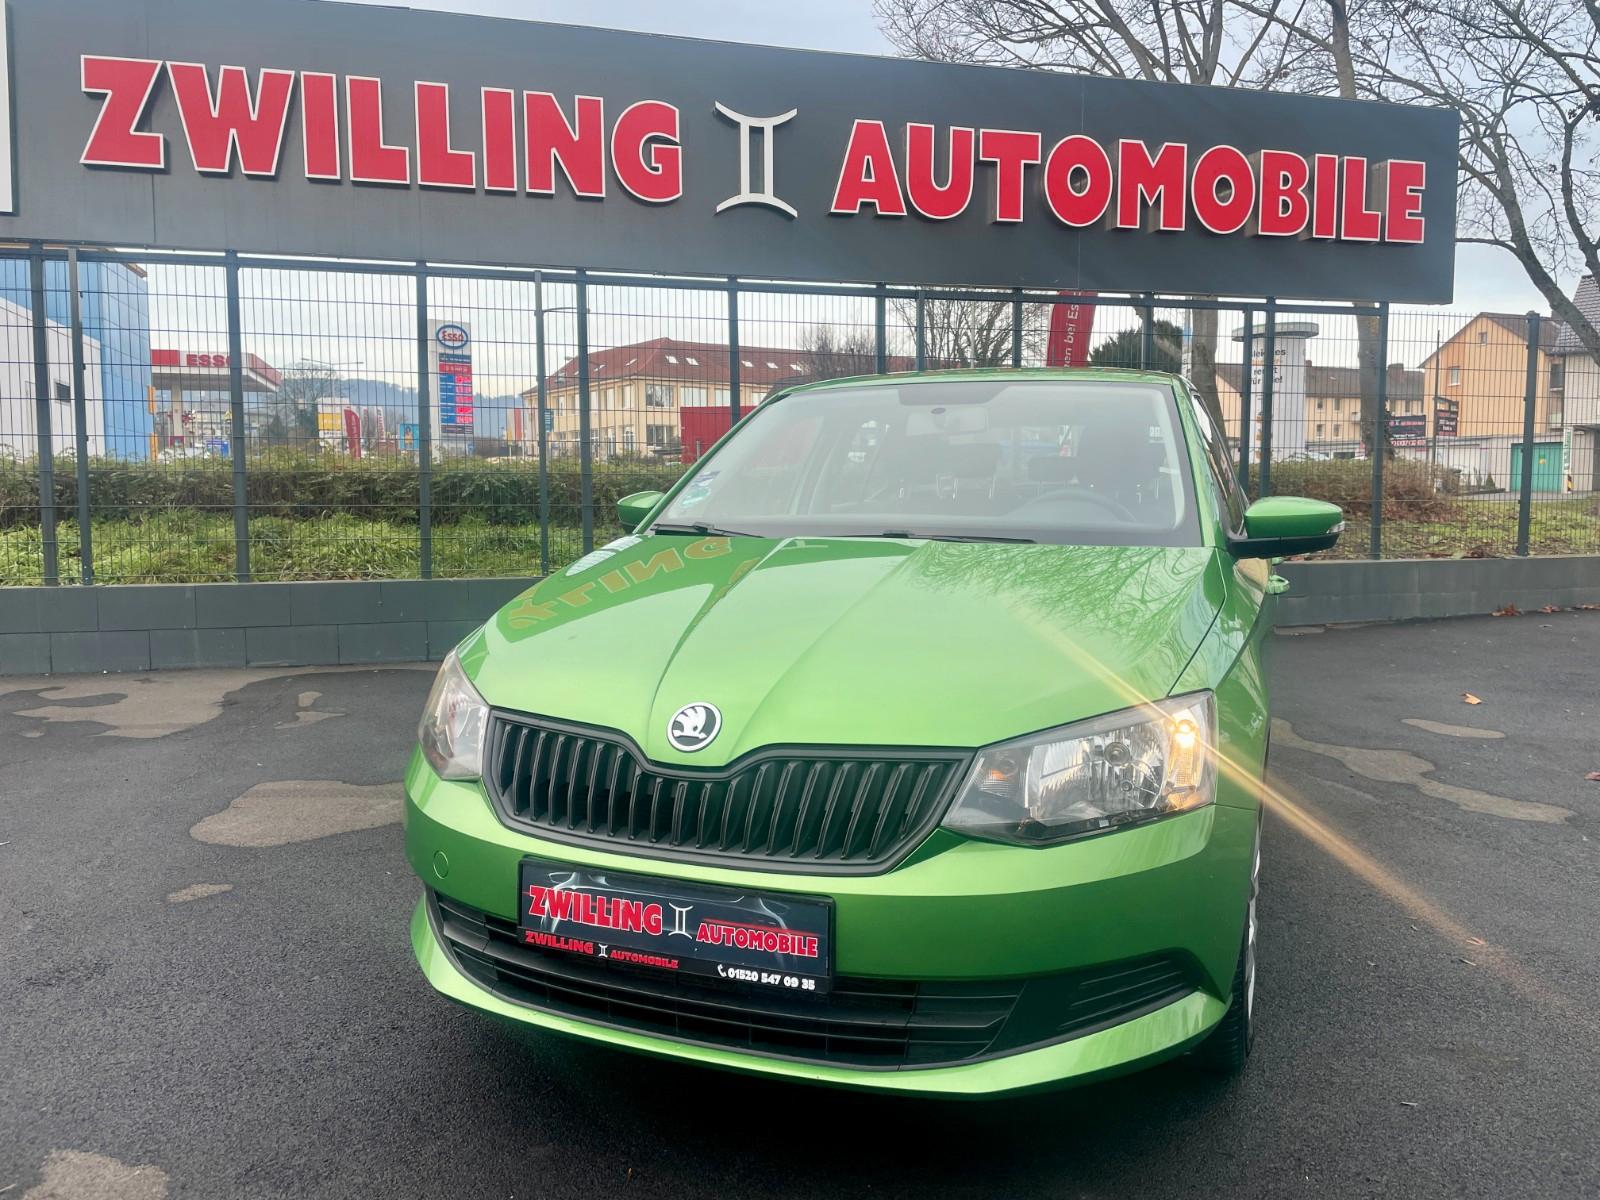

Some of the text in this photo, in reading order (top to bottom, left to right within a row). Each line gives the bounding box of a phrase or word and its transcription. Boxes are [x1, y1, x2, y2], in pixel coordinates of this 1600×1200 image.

[80, 54, 1426, 245] ZWILLING AUTOMOBILE
[441, 330, 465, 342] Esso
[1064, 323, 1075, 343] bei
[528, 884, 818, 958] ZWILLING AUTOMOBILE
[525, 930, 679, 969] ZWILLING AUTOMOBILE
[727, 967, 816, 990] 01520 547 09 35
